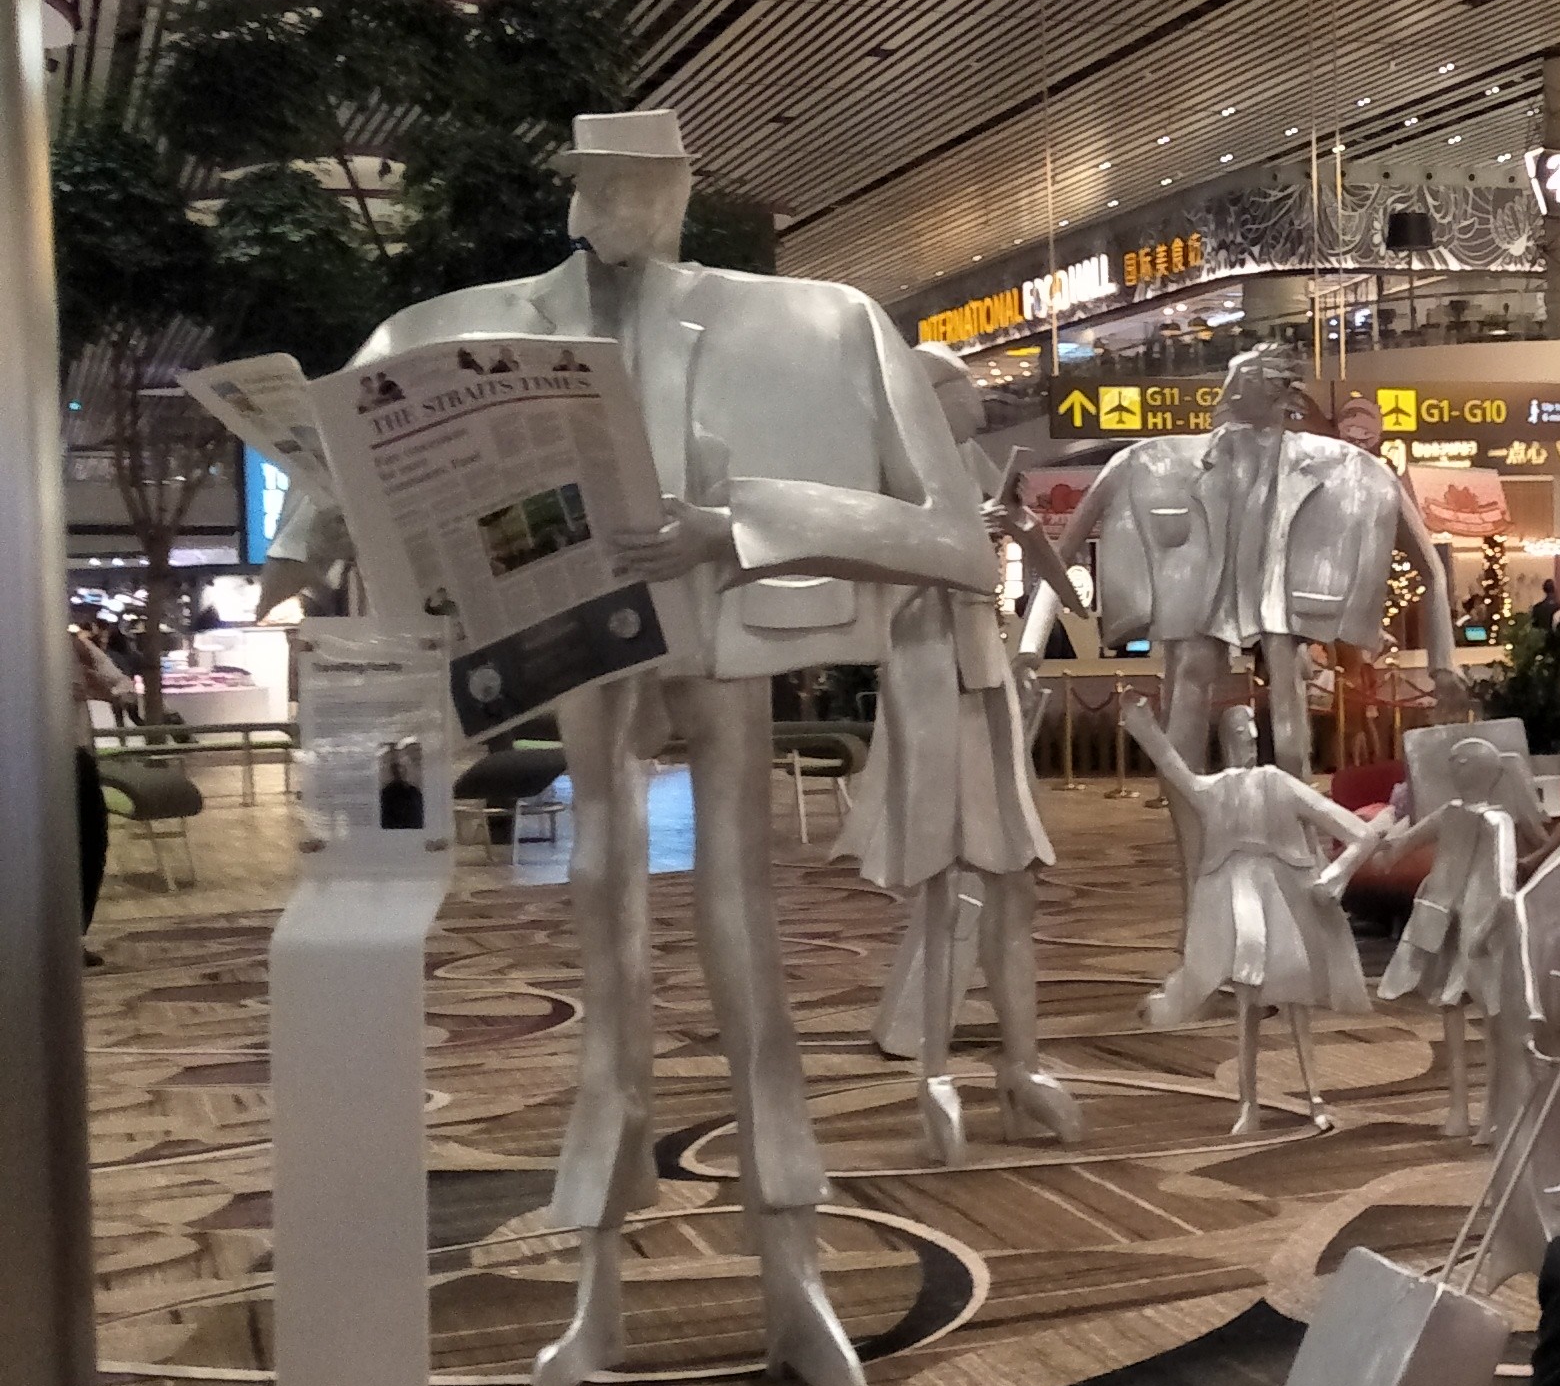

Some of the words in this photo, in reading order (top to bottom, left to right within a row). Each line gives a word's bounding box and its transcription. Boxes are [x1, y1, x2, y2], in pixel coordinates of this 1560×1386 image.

[918, 287, 1024, 343] INTERNATIONAL
[373, 407, 414, 434] THE
[422, 376, 514, 414] STRAITS
[519, 375, 592, 391] TIMES
[1147, 411, 1173, 430] H1
[1488, 440, 1548, 465] 一点心
